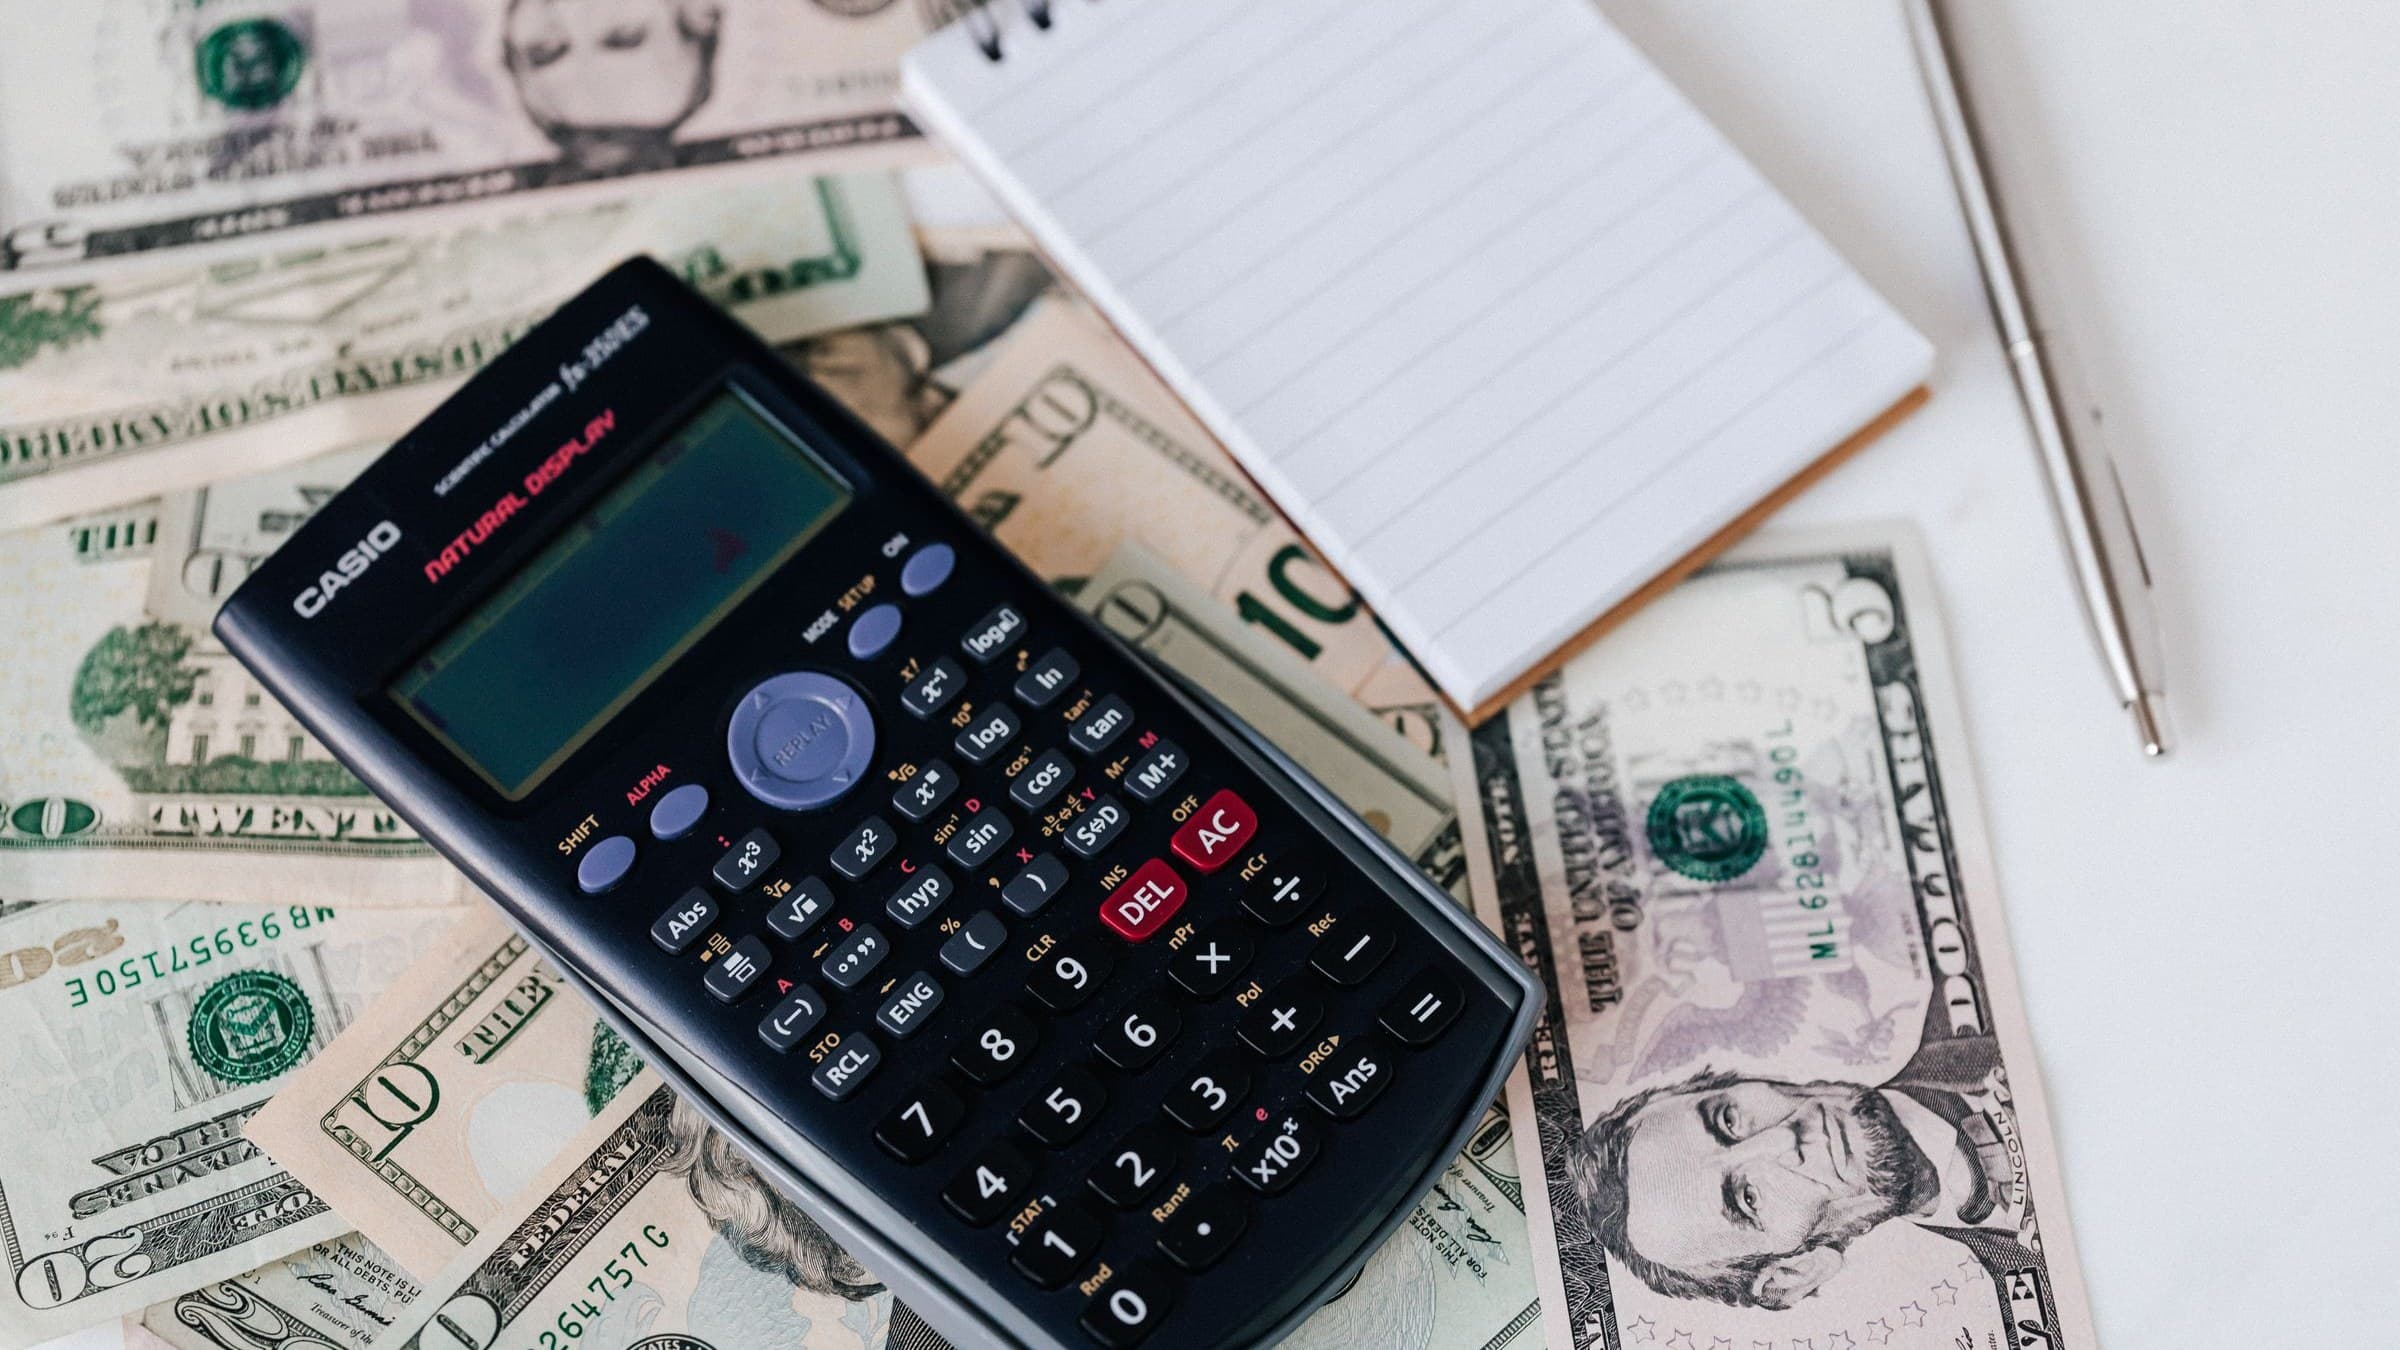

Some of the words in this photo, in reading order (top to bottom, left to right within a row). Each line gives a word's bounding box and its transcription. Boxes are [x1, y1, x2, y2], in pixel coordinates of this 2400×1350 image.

[424, 492, 528, 584] NATURAL
[524, 408, 615, 496] DISPLAY
[881, 530, 911, 558] ON
[293, 520, 401, 618] CASIO
[801, 608, 841, 645] MODE
[837, 573, 876, 612] SETUP
[1235, 544, 1359, 661] 10
[1035, 667, 1064, 690] ln
[774, 712, 834, 769] REPLAY
[968, 716, 1010, 750] log
[1085, 707, 1123, 740] tan
[1138, 731, 1159, 749] M
[626, 763, 672, 806] ALPHA
[1027, 762, 1062, 795] cos
[1138, 753, 1176, 790] M+
[965, 798, 981, 813] D
[1081, 787, 1096, 801] Y
[1171, 794, 1201, 824] OFF
[148, 802, 422, 844] TWENT
[558, 814, 600, 855] SHIFT
[965, 822, 999, 854] sin
[1197, 808, 1241, 855] AC
[1487, 776, 1522, 866] NOTE
[1772, 744, 1829, 912] 62814490
[900, 859, 916, 874] C
[1016, 847, 1034, 864] X
[1240, 852, 1270, 882] nCr
[1554, 786, 1607, 926] UNITED
[1876, 679, 1989, 1039] DOLLARS
[1100, 864, 1128, 891] INS
[897, 877, 940, 915] hyp
[1118, 878, 1175, 926] DEL
[1606, 883, 1646, 933] OF
[668, 901, 707, 940] Abs
[838, 917, 854, 933] B
[939, 917, 961, 935] %
[1168, 921, 1197, 951] nPr
[1307, 911, 1338, 938] Rec
[96, 912, 282, 996] 93957150
[1025, 933, 1057, 963] CLR
[1807, 920, 1839, 962] ML
[776, 977, 793, 995] A
[1055, 956, 1088, 990] 9
[1578, 930, 1624, 1014] THE
[64, 977, 89, 1008] E
[888, 981, 934, 1025] ENG
[1235, 981, 1264, 1008] Pol
[808, 1031, 841, 1064] STO
[979, 1028, 1016, 1062] 8
[1124, 1013, 1158, 1048] 6
[826, 1047, 870, 1087] RCL
[1328, 1056, 1378, 1105] Ans
[323, 1061, 440, 1163] 10
[1045, 1086, 1082, 1125] 5
[1190, 1076, 1227, 1112] 3
[900, 1100, 934, 1137] 7
[1255, 1107, 1269, 1121] e
[1115, 1150, 1156, 1188] 2
[1992, 1110, 2025, 1206] LINCOLN
[69, 1137, 266, 1219] TATES
[975, 1165, 1008, 1200] 4
[1461, 1177, 1496, 1215] Treasurer
[230, 1190, 313, 1231] OTE
[509, 1138, 648, 1271] FEDERAL
[1009, 1199, 1045, 1235] STAT
[1151, 1182, 1192, 1223] Ran#
[642, 1223, 670, 1249] G
[1043, 1229, 1077, 1259] 1
[1408, 1216, 1436, 1244] NOTE
[1450, 1234, 1472, 1258] ALL
[16, 1226, 152, 1311] 20
[312, 1243, 330, 1257] OR
[330, 1252, 351, 1271] ALL
[338, 1243, 363, 1264] THIS
[364, 1260, 396, 1282] NOTE
[396, 1278, 409, 1290] IS
[1436, 1240, 1460, 1267] THIS
[1466, 1256, 1488, 1280] FOR
[1079, 1262, 1114, 1297] Rnd
[309, 1302, 351, 1331] Treasurer
[350, 1327, 362, 1338] of
[1109, 1288, 1148, 1325] 0
